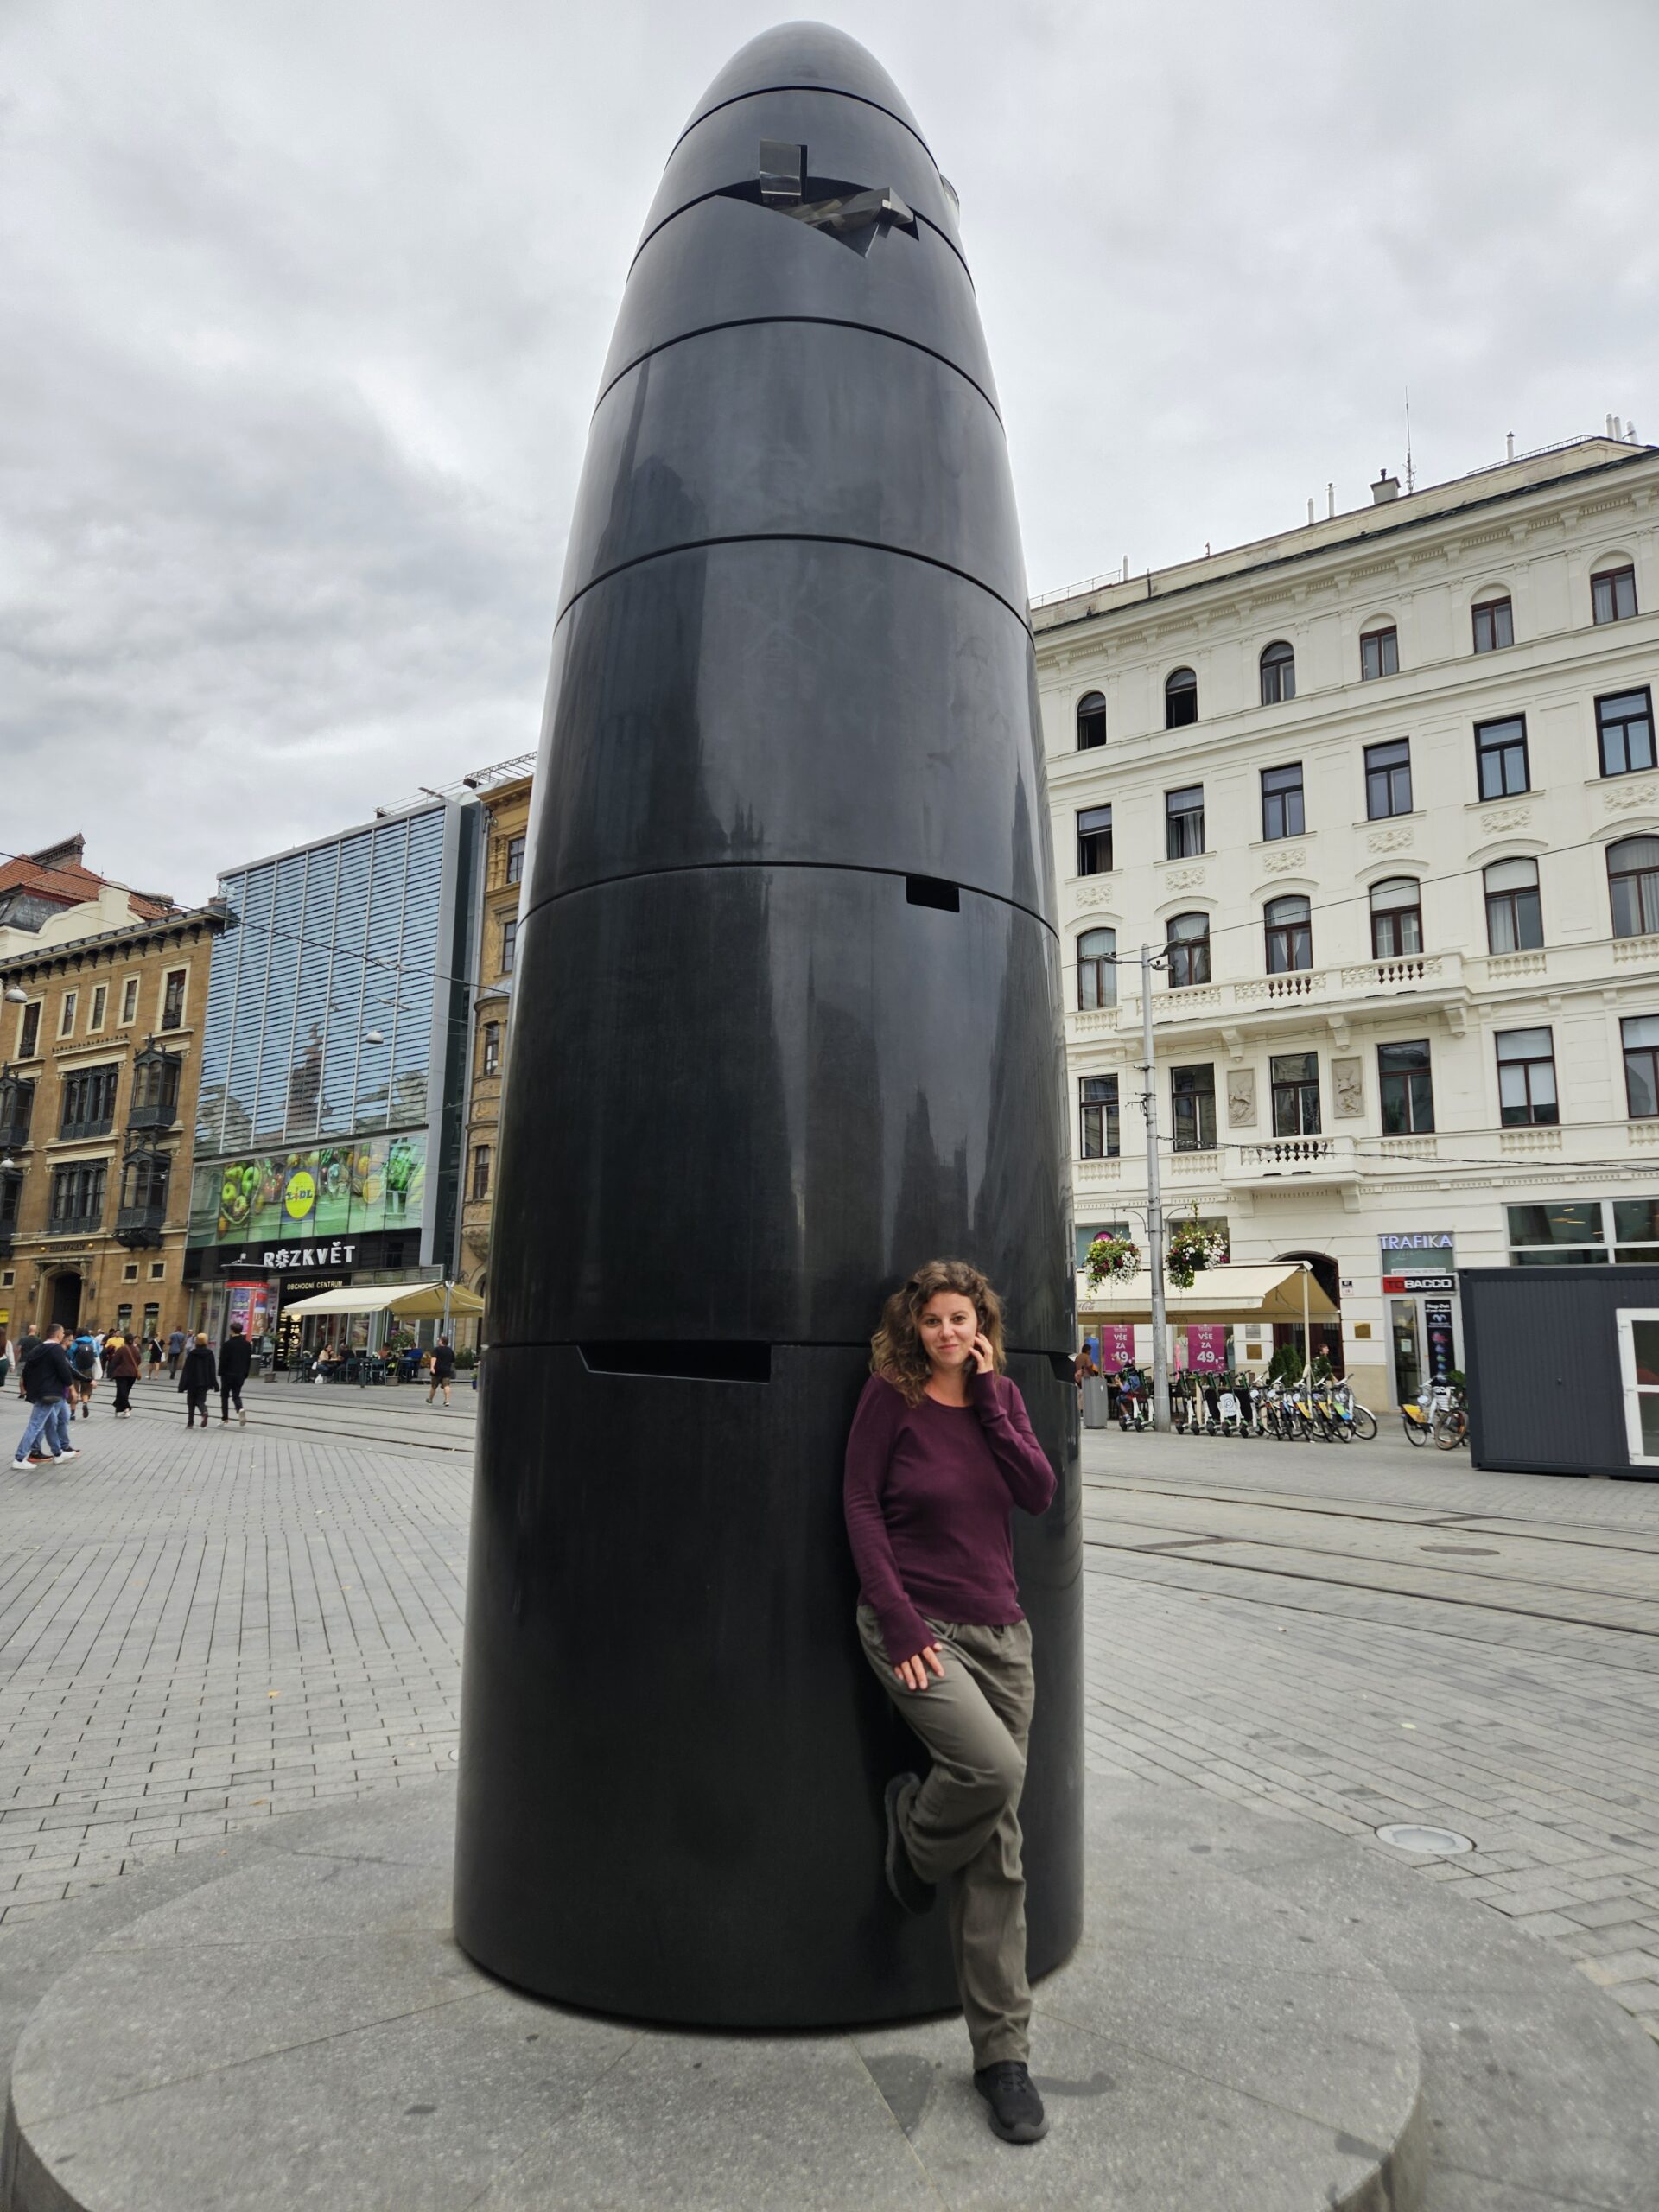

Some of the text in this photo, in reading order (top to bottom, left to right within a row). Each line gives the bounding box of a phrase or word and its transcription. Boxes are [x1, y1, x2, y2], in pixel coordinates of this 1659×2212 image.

[1379, 1234, 1453, 1249] TRAFIKA
[263, 1241, 356, 1268] ROZKVĚT
[287, 1281, 315, 1290] OBCHODNÍ
[1387, 1279, 1452, 1289] TOBACCO
[1197, 1351, 1224, 1364] 49,-
